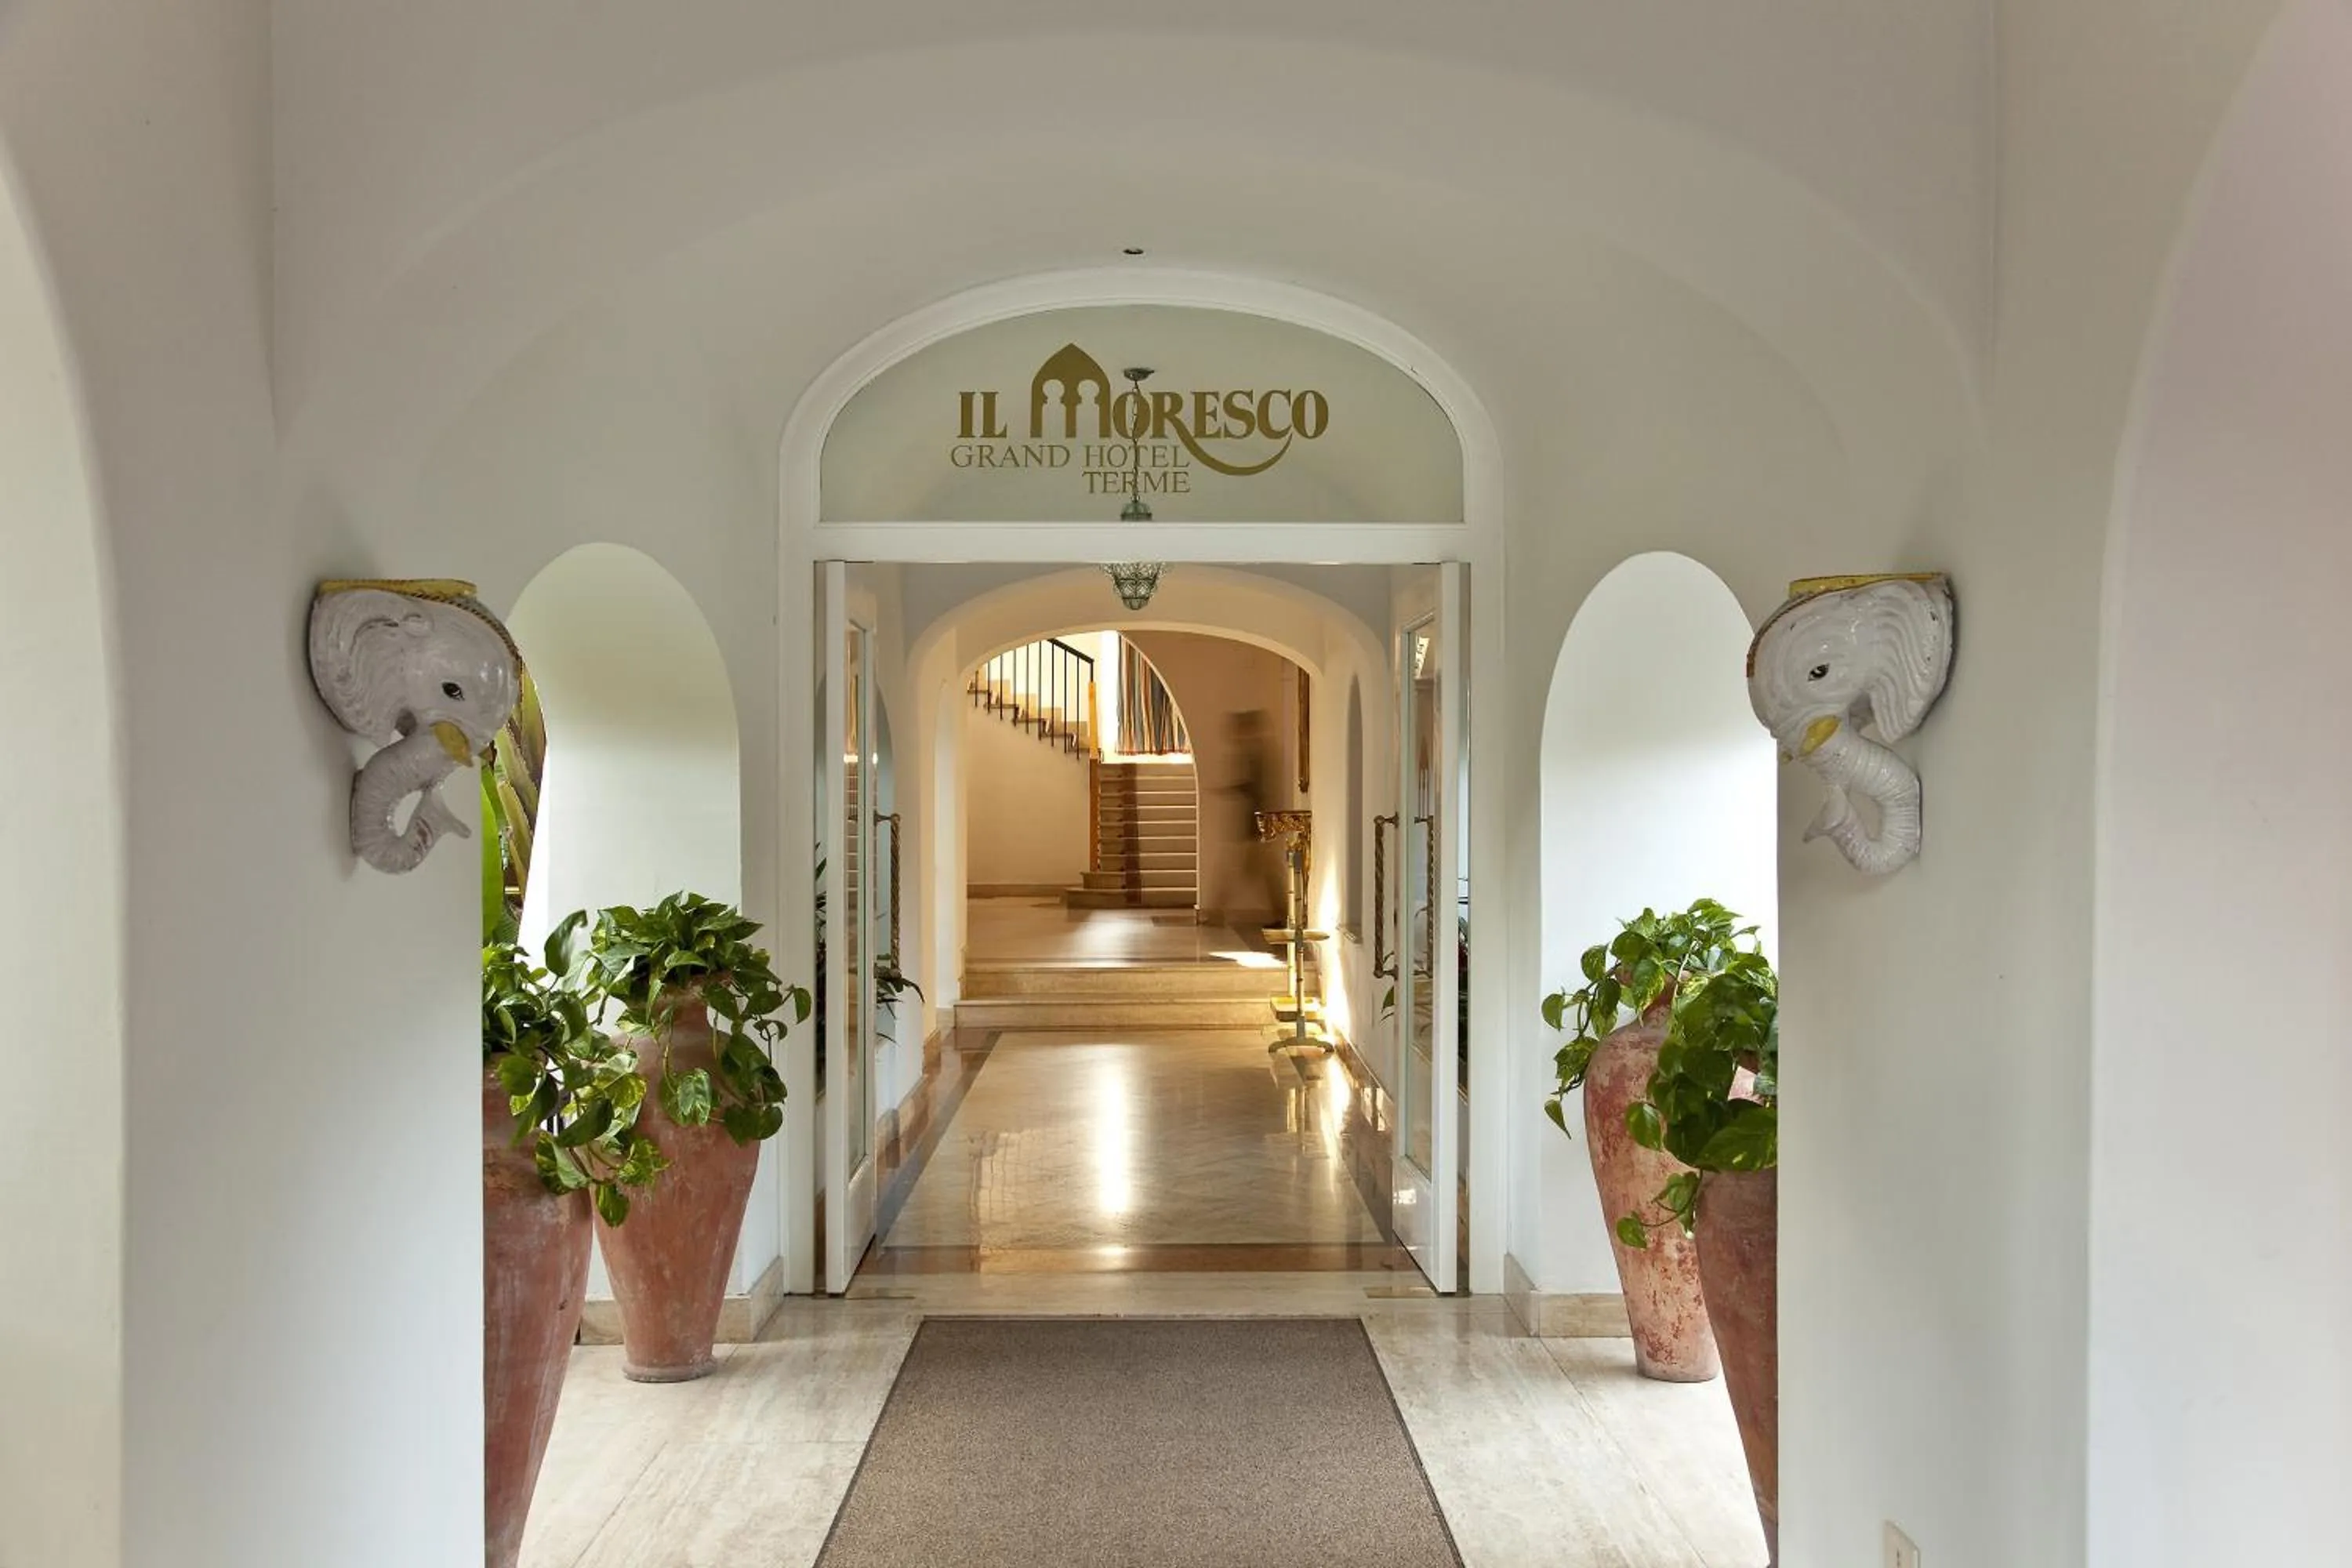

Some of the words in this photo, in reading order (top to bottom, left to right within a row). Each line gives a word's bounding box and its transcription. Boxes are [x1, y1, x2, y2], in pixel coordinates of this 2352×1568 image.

[956, 391, 1007, 438] IL
[1029, 343, 1329, 476] MORESCO
[951, 444, 1071, 469] GRAND
[1083, 444, 1191, 469] HOTEL
[1082, 470, 1191, 494] TERME
